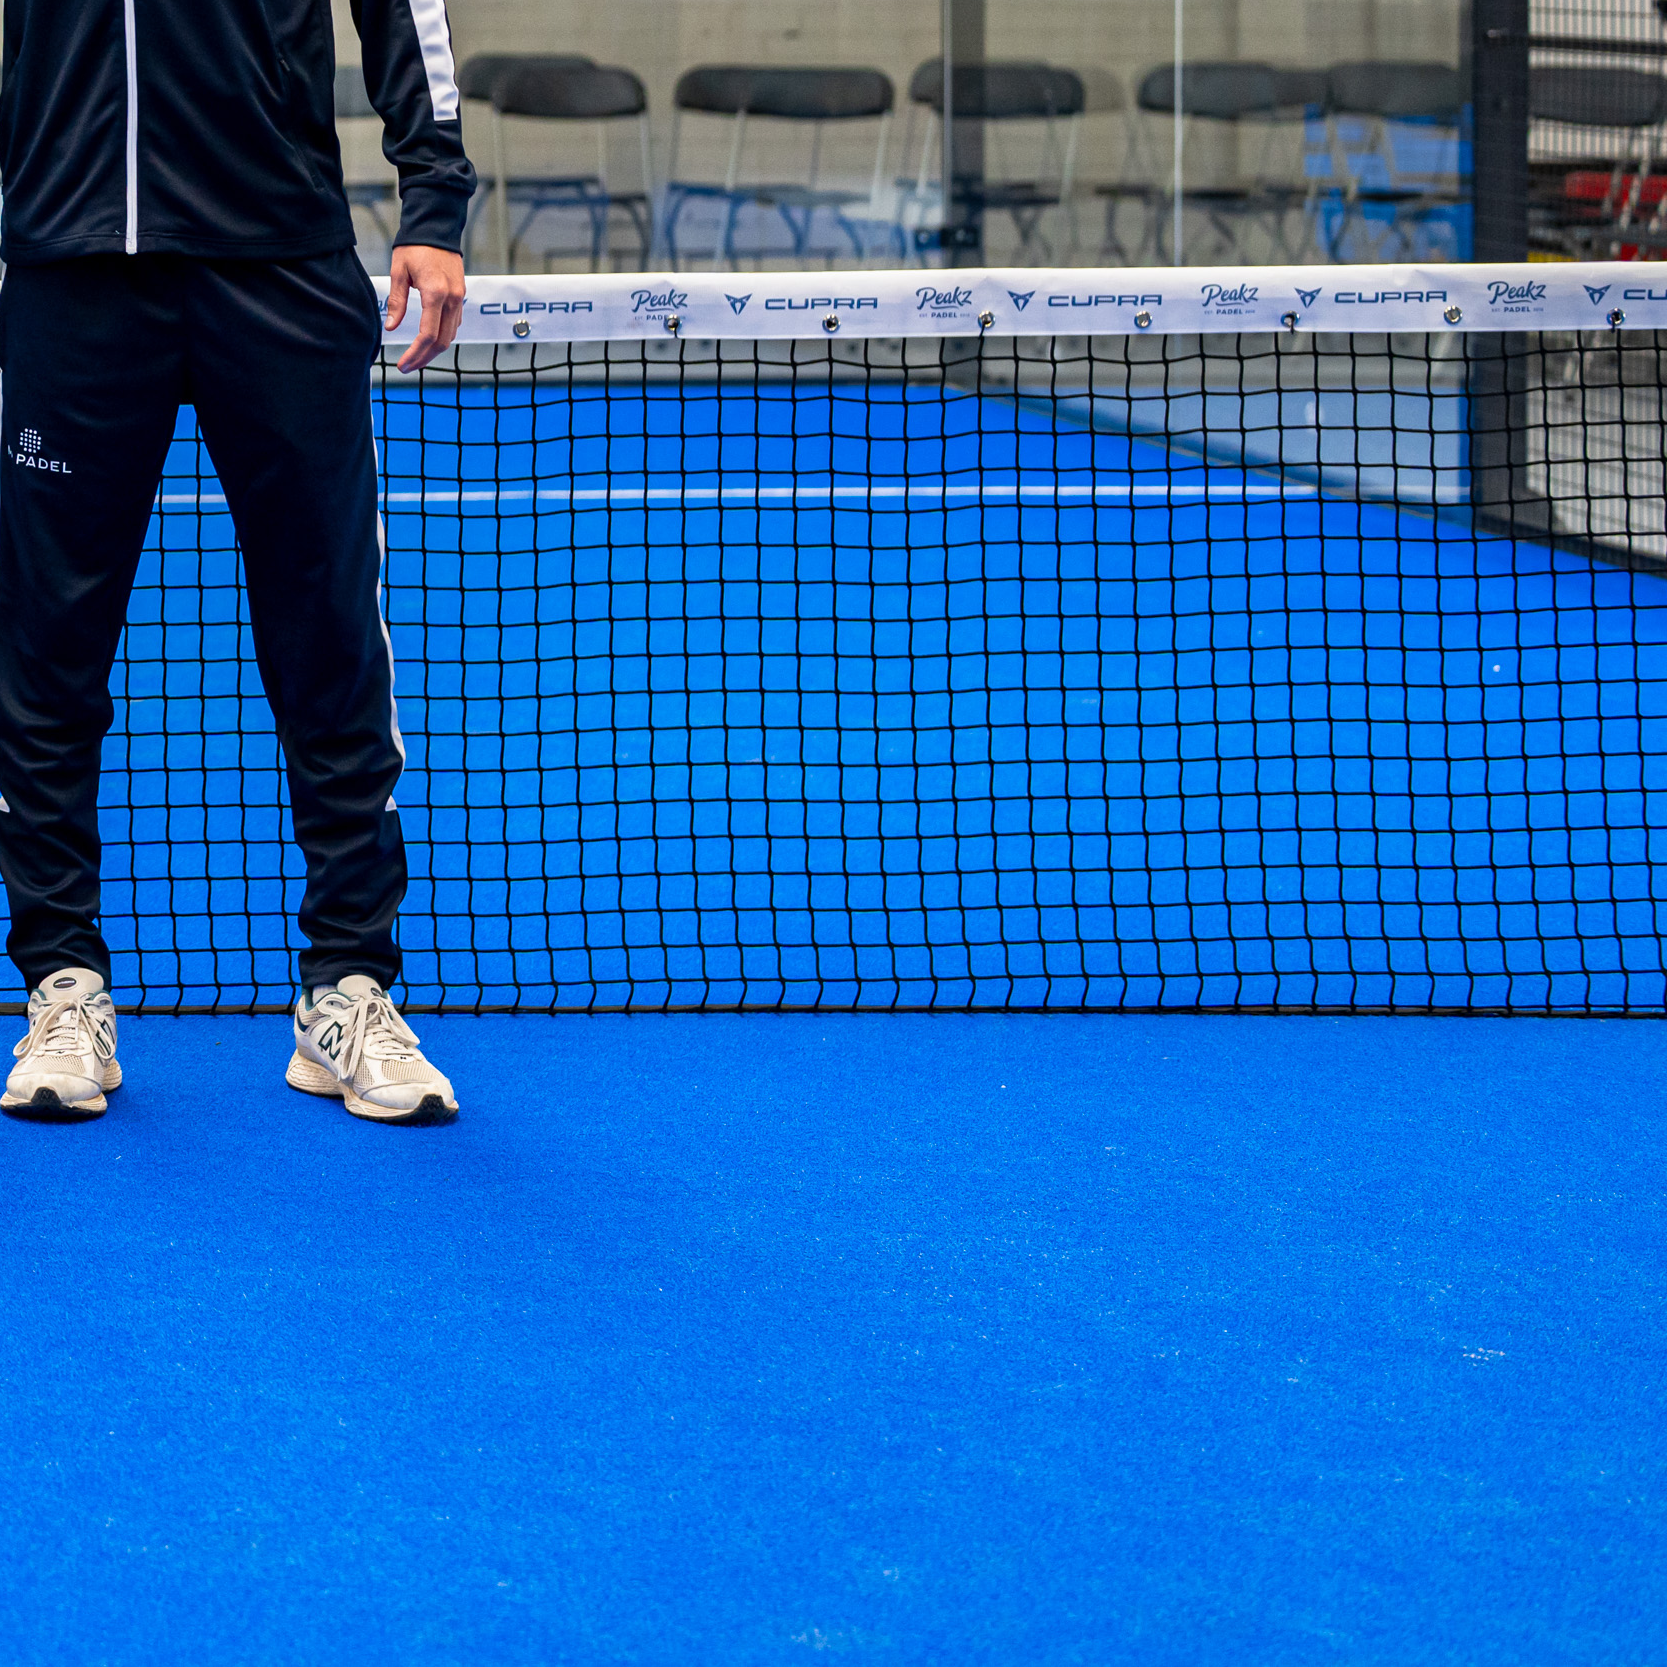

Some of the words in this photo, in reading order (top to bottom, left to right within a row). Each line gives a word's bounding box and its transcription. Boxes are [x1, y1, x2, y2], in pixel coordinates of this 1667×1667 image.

[630, 288, 688, 313] Peakz
[764, 296, 878, 310] CUPRA
[915, 286, 973, 310] Peakz
[1047, 294, 1163, 308] CUPRA
[1201, 283, 1259, 307] Peakz
[1334, 290, 1447, 304] CUPRA
[1487, 280, 1547, 305] Peakz
[479, 299, 593, 315] CUPRA
[15, 453, 73, 474] PADEL
